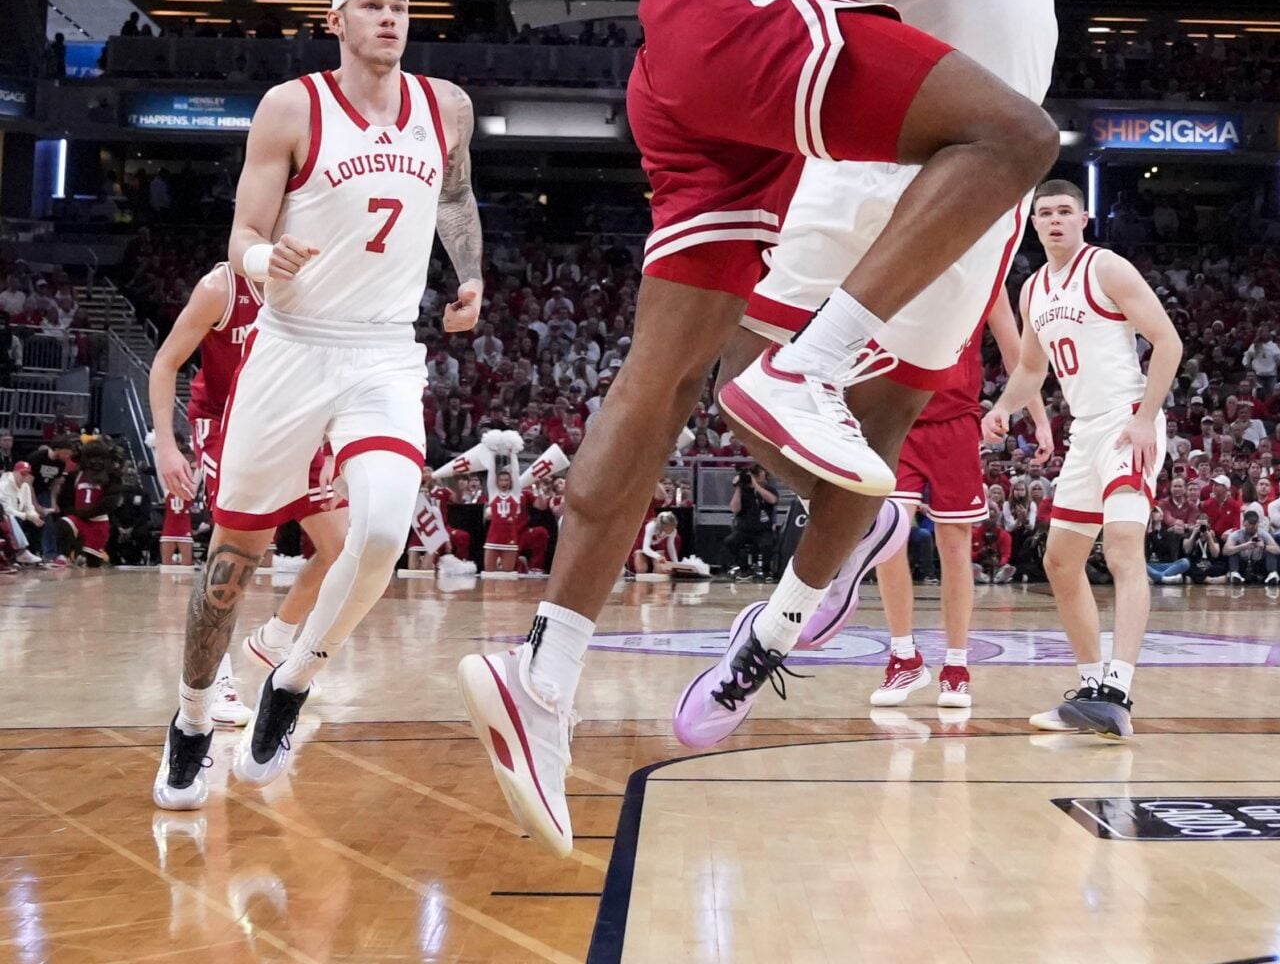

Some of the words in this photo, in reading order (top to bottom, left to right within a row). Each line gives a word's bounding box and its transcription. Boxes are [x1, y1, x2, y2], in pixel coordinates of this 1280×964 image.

[192, 116, 215, 126] HIRE
[1092, 120, 1239, 144] SHIPSIGMA
[324, 154, 437, 188] LOUISVILLE
[365, 198, 404, 254] 7
[1034, 306, 1086, 332] OUISVILLE
[1050, 337, 1079, 378] 10
